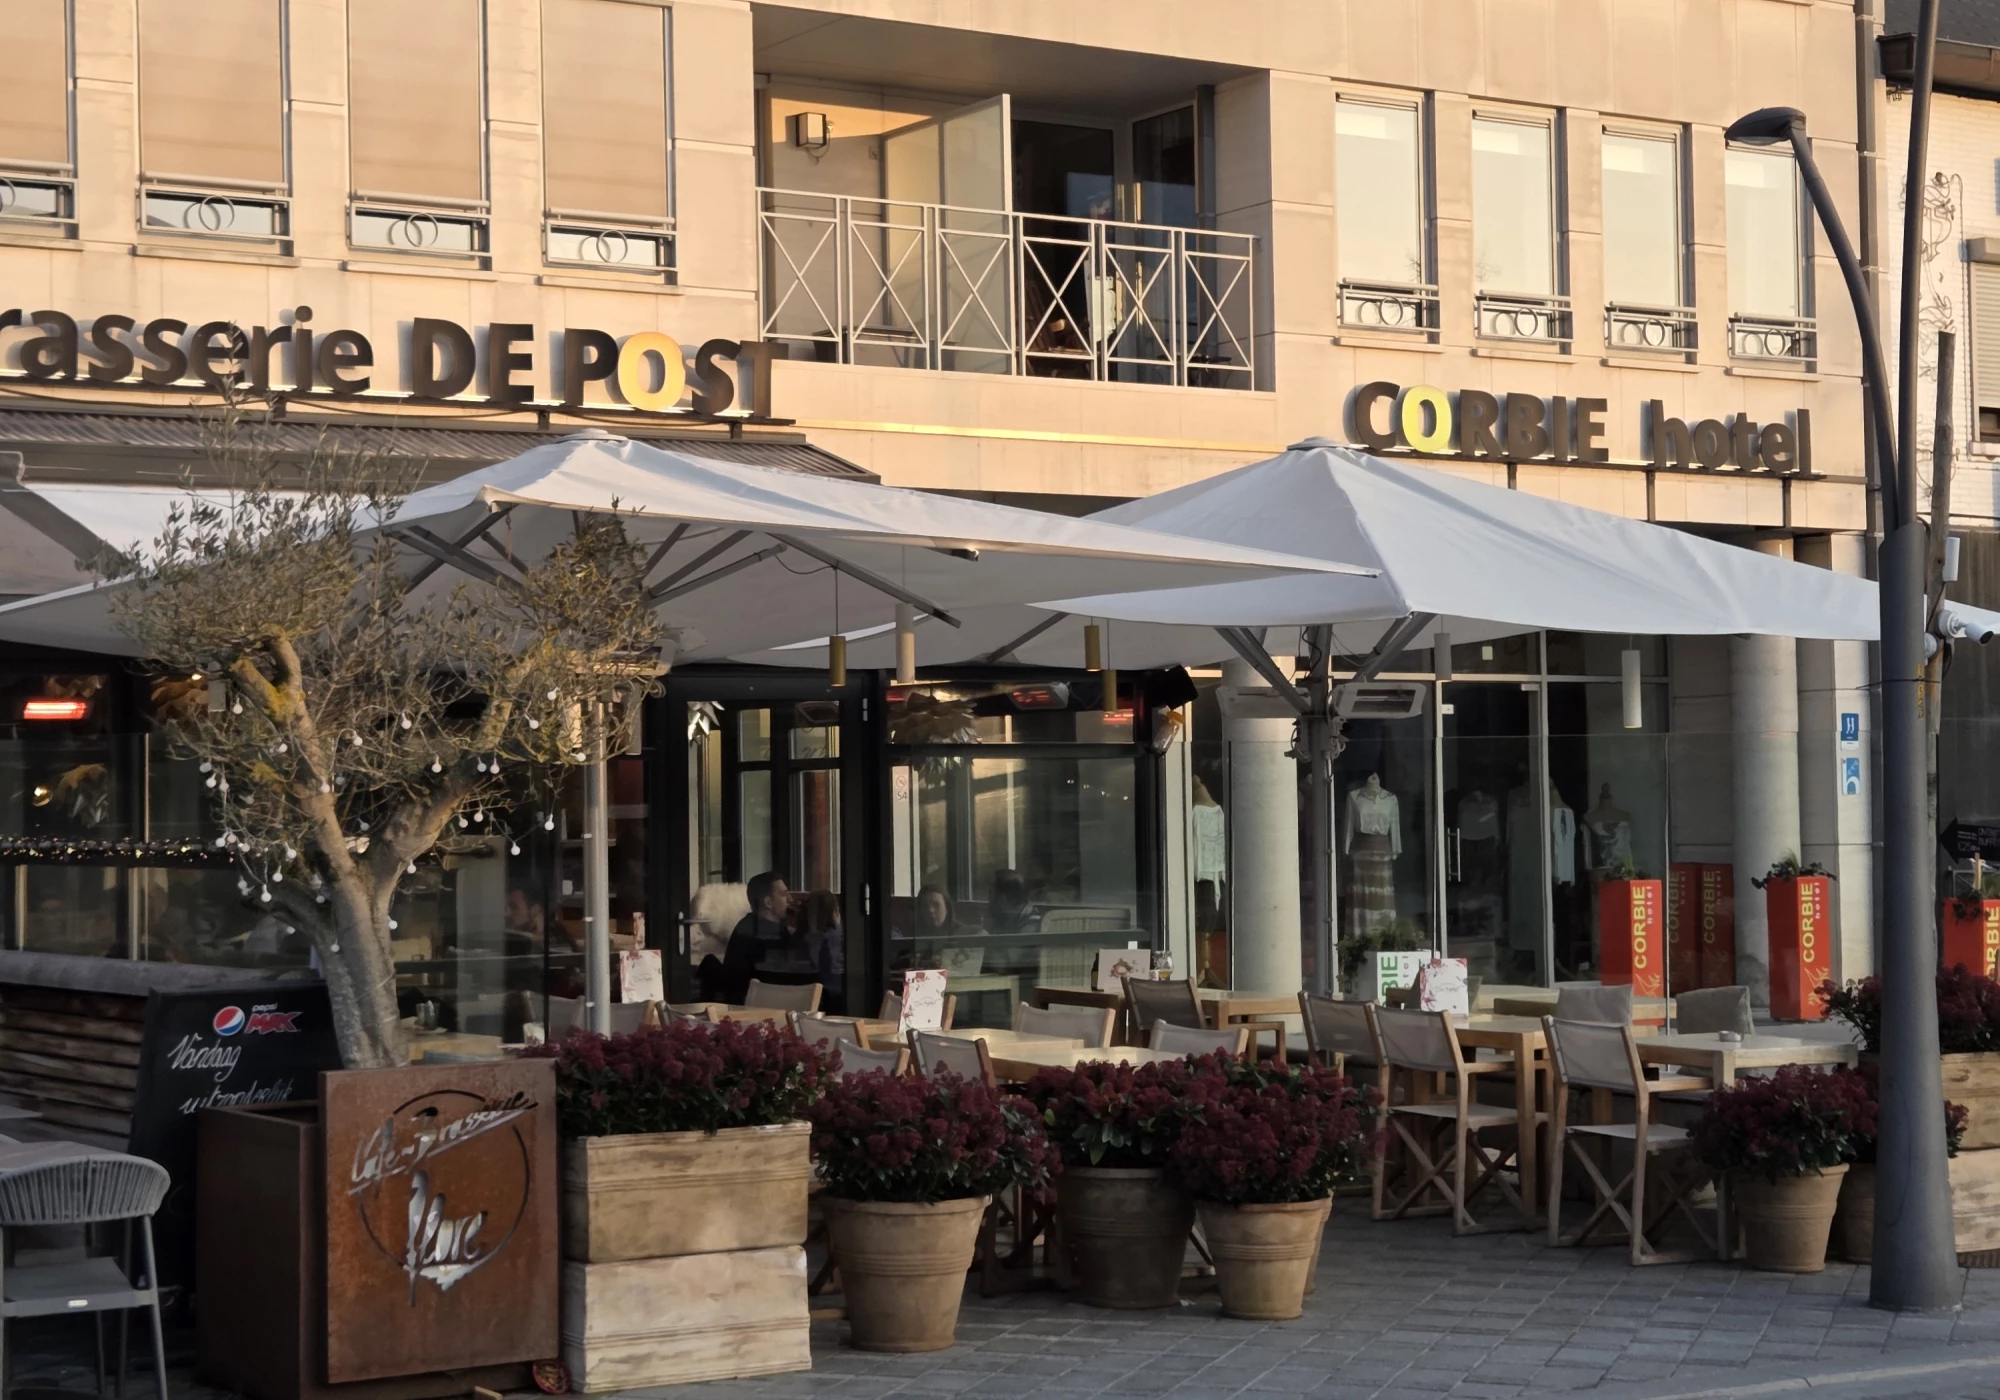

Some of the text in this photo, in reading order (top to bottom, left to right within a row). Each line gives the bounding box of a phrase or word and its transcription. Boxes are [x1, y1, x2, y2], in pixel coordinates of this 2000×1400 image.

[412, 317, 534, 402] DE
[564, 327, 789, 418] POST
[1355, 381, 1812, 477] CORBIE hotel
[1633, 886, 1647, 969] CORBIE
[1646, 885, 1654, 924] hotel
[1669, 871, 1680, 944] CORBIE
[1703, 870, 1715, 944] CORBIE
[1801, 883, 1815, 963] CORBIE
[167, 1033, 242, 1083] Vandaag
[244, 1011, 304, 1035] MAX
